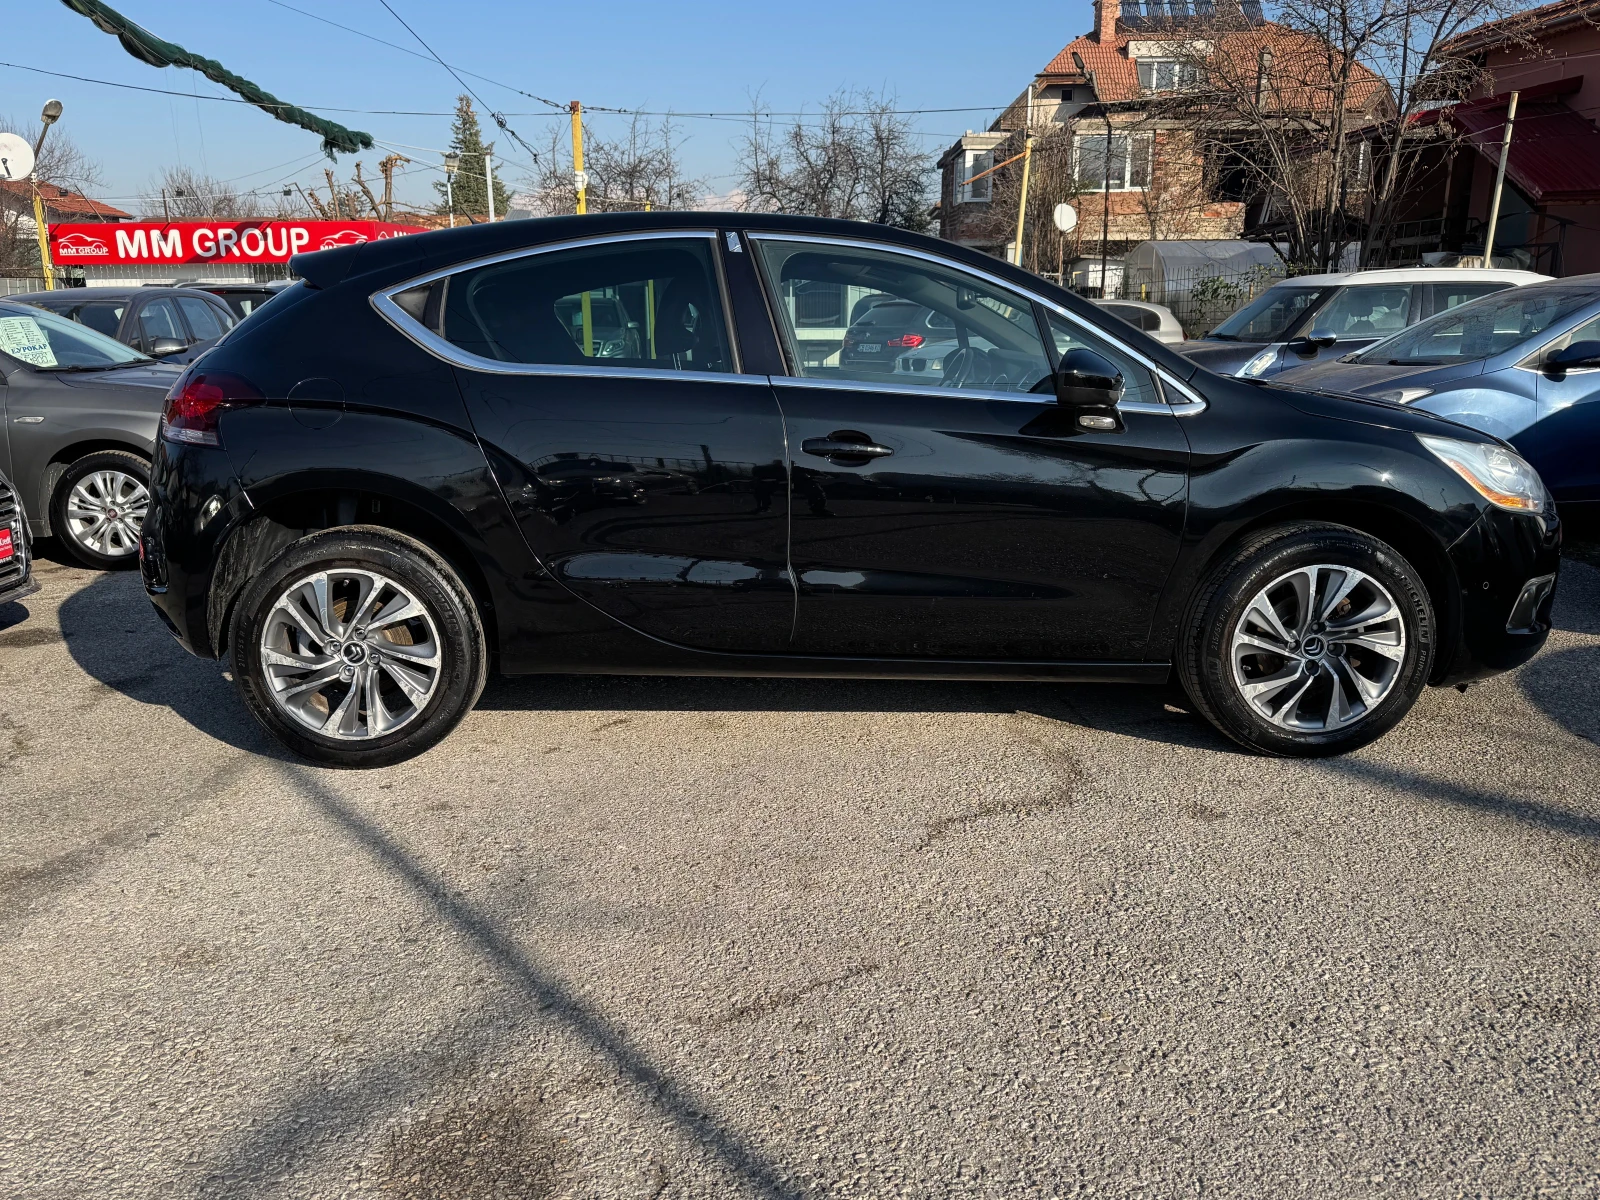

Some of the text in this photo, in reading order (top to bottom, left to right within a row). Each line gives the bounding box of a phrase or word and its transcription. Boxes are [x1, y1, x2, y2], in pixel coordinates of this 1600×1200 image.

[59, 247, 108, 255] MM GROUP
[115, 226, 310, 258] MM GROUP
[1399, 574, 1429, 641] MICHELIN
